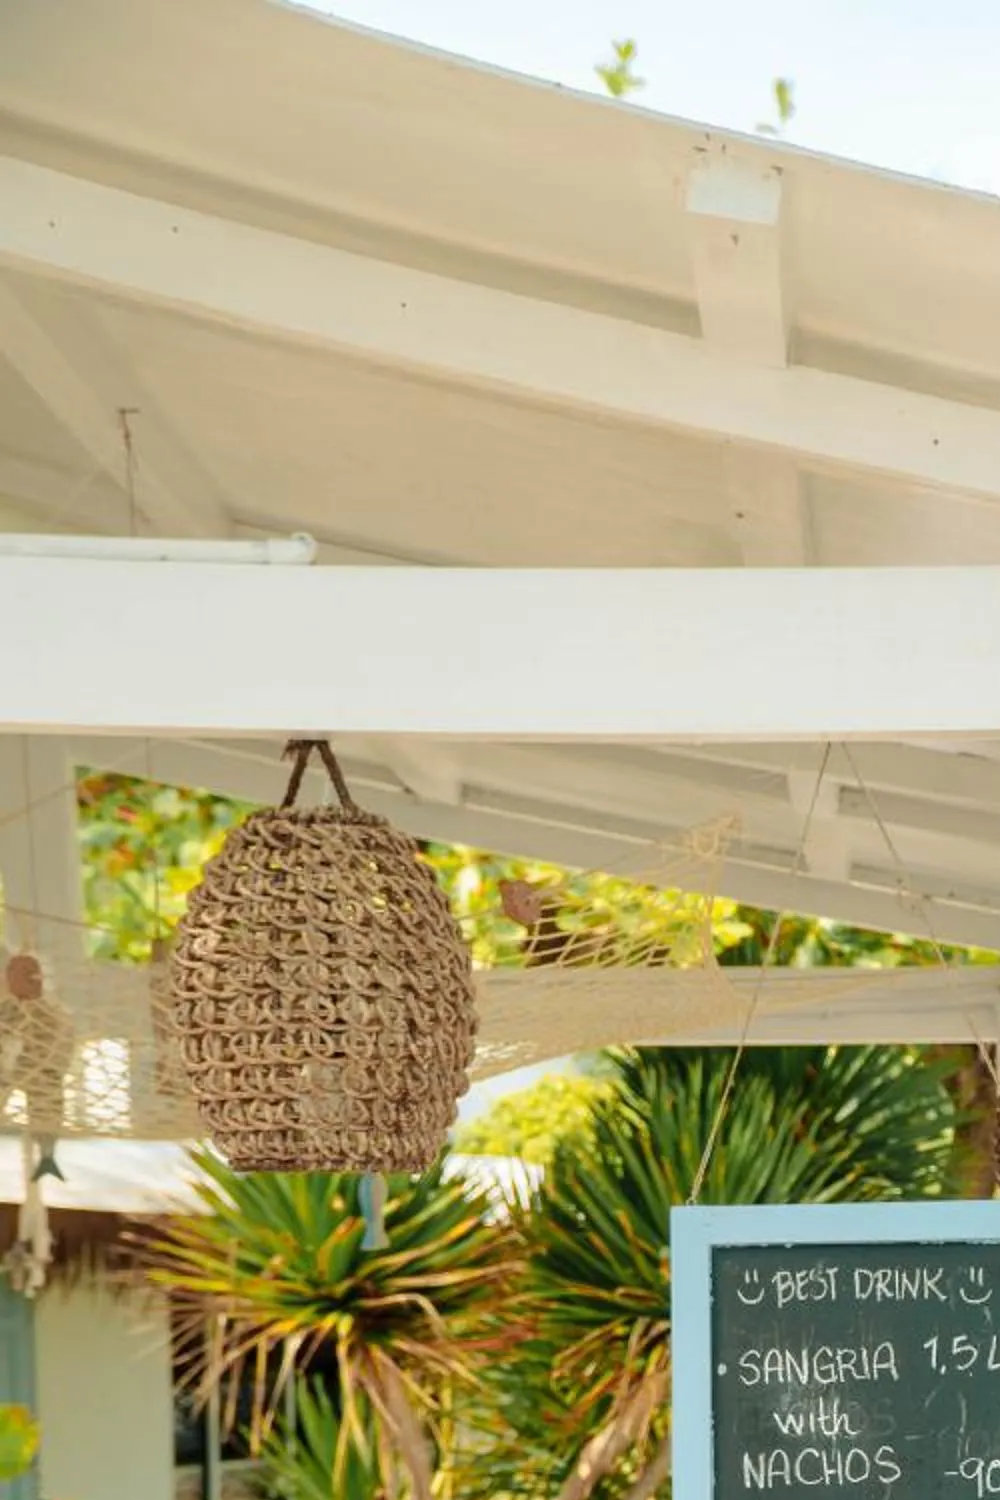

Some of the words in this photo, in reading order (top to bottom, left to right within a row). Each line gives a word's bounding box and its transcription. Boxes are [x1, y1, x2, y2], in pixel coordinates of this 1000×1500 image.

[772, 1266, 838, 1308] BEST
[854, 1267, 947, 1301] DRINK
[738, 1341, 900, 1386] SANGRIA
[773, 1396, 859, 1436] with
[743, 1445, 901, 1489] NACHOS
